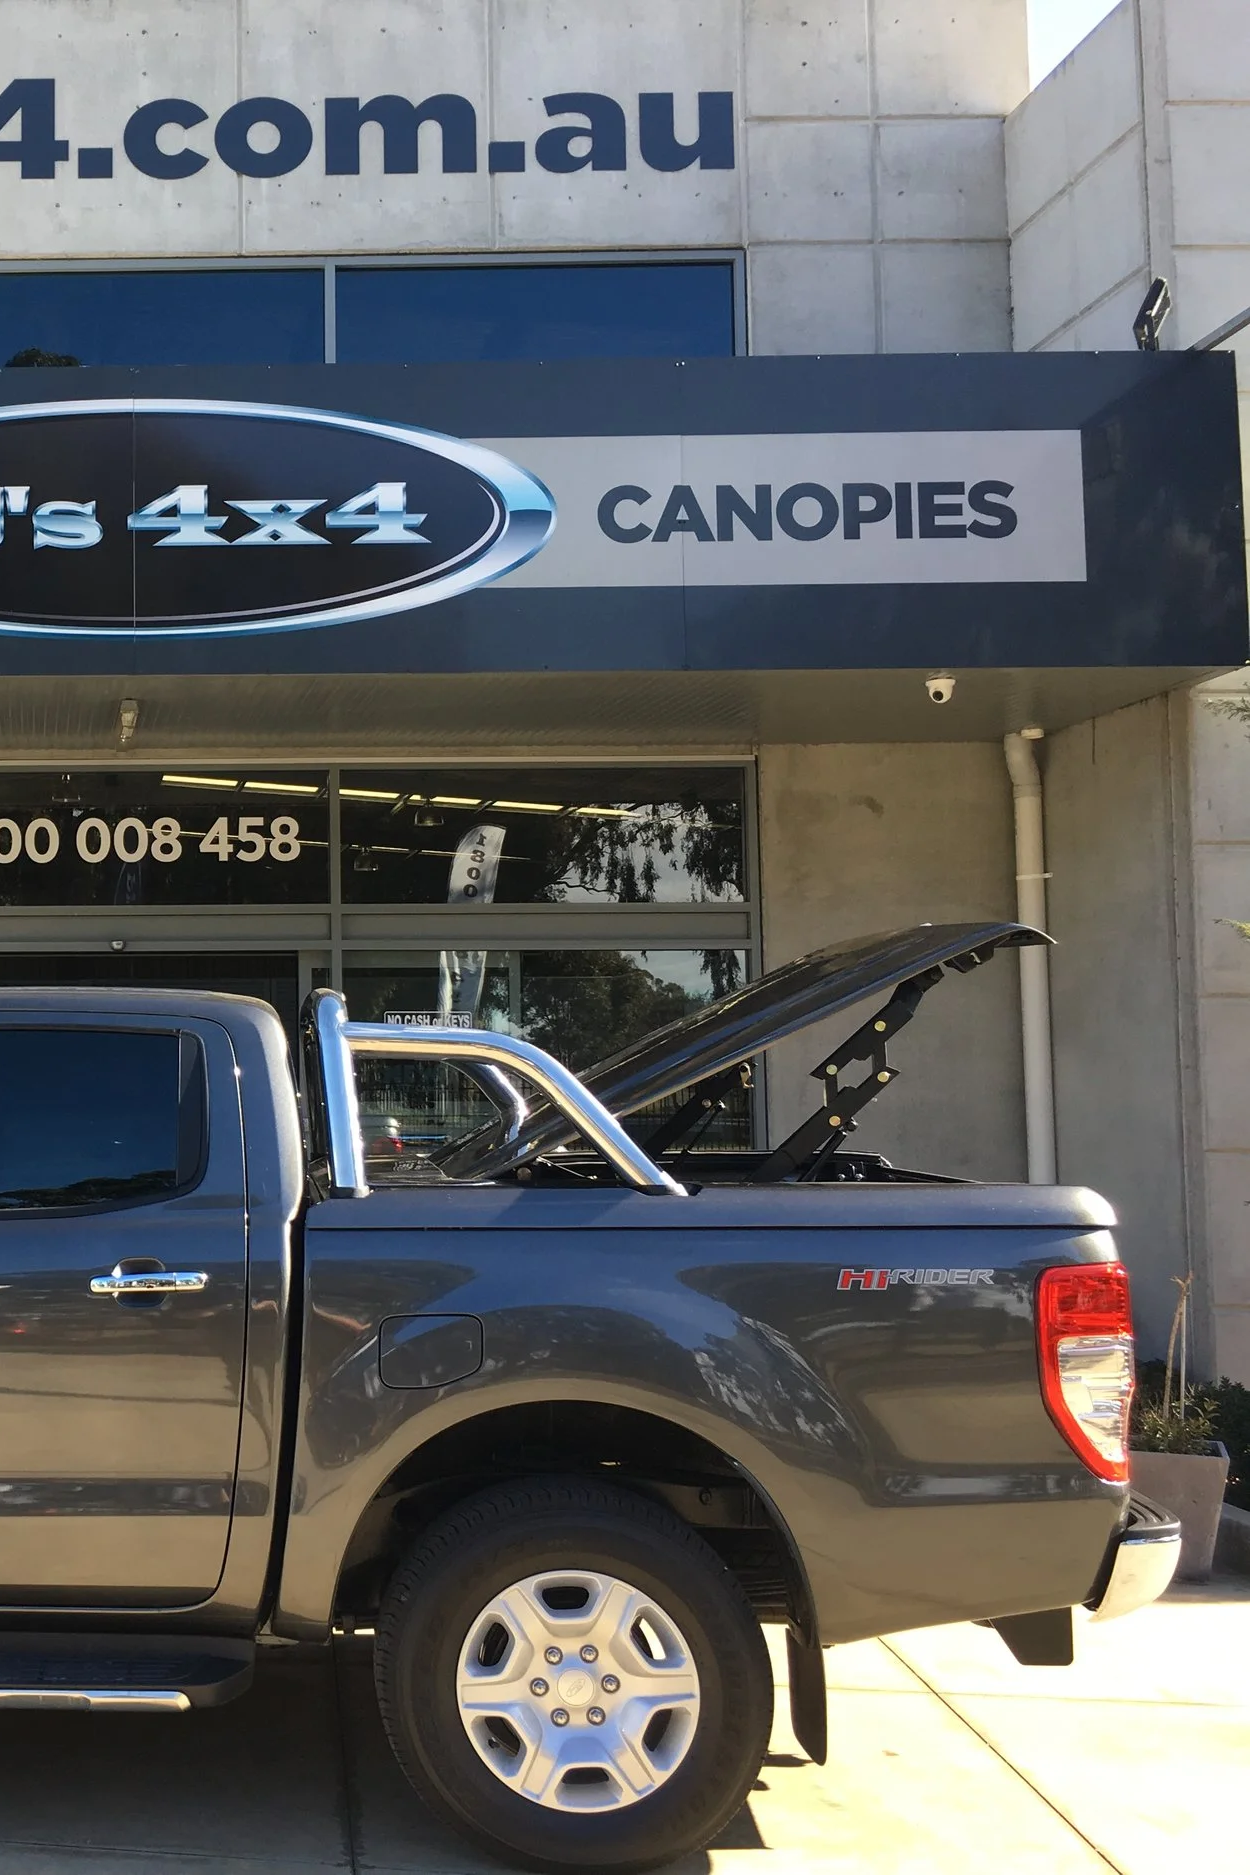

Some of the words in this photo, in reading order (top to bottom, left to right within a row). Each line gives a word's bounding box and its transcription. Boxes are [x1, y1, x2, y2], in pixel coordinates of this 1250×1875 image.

[127, 481, 433, 546] 4x4
[597, 479, 1018, 544] CANOPIES
[76, 816, 183, 863] 008
[199, 815, 301, 862] 458
[387, 1014, 401, 1024] NO
[404, 1014, 430, 1026] CASH
[444, 1014, 470, 1028] KEYS
